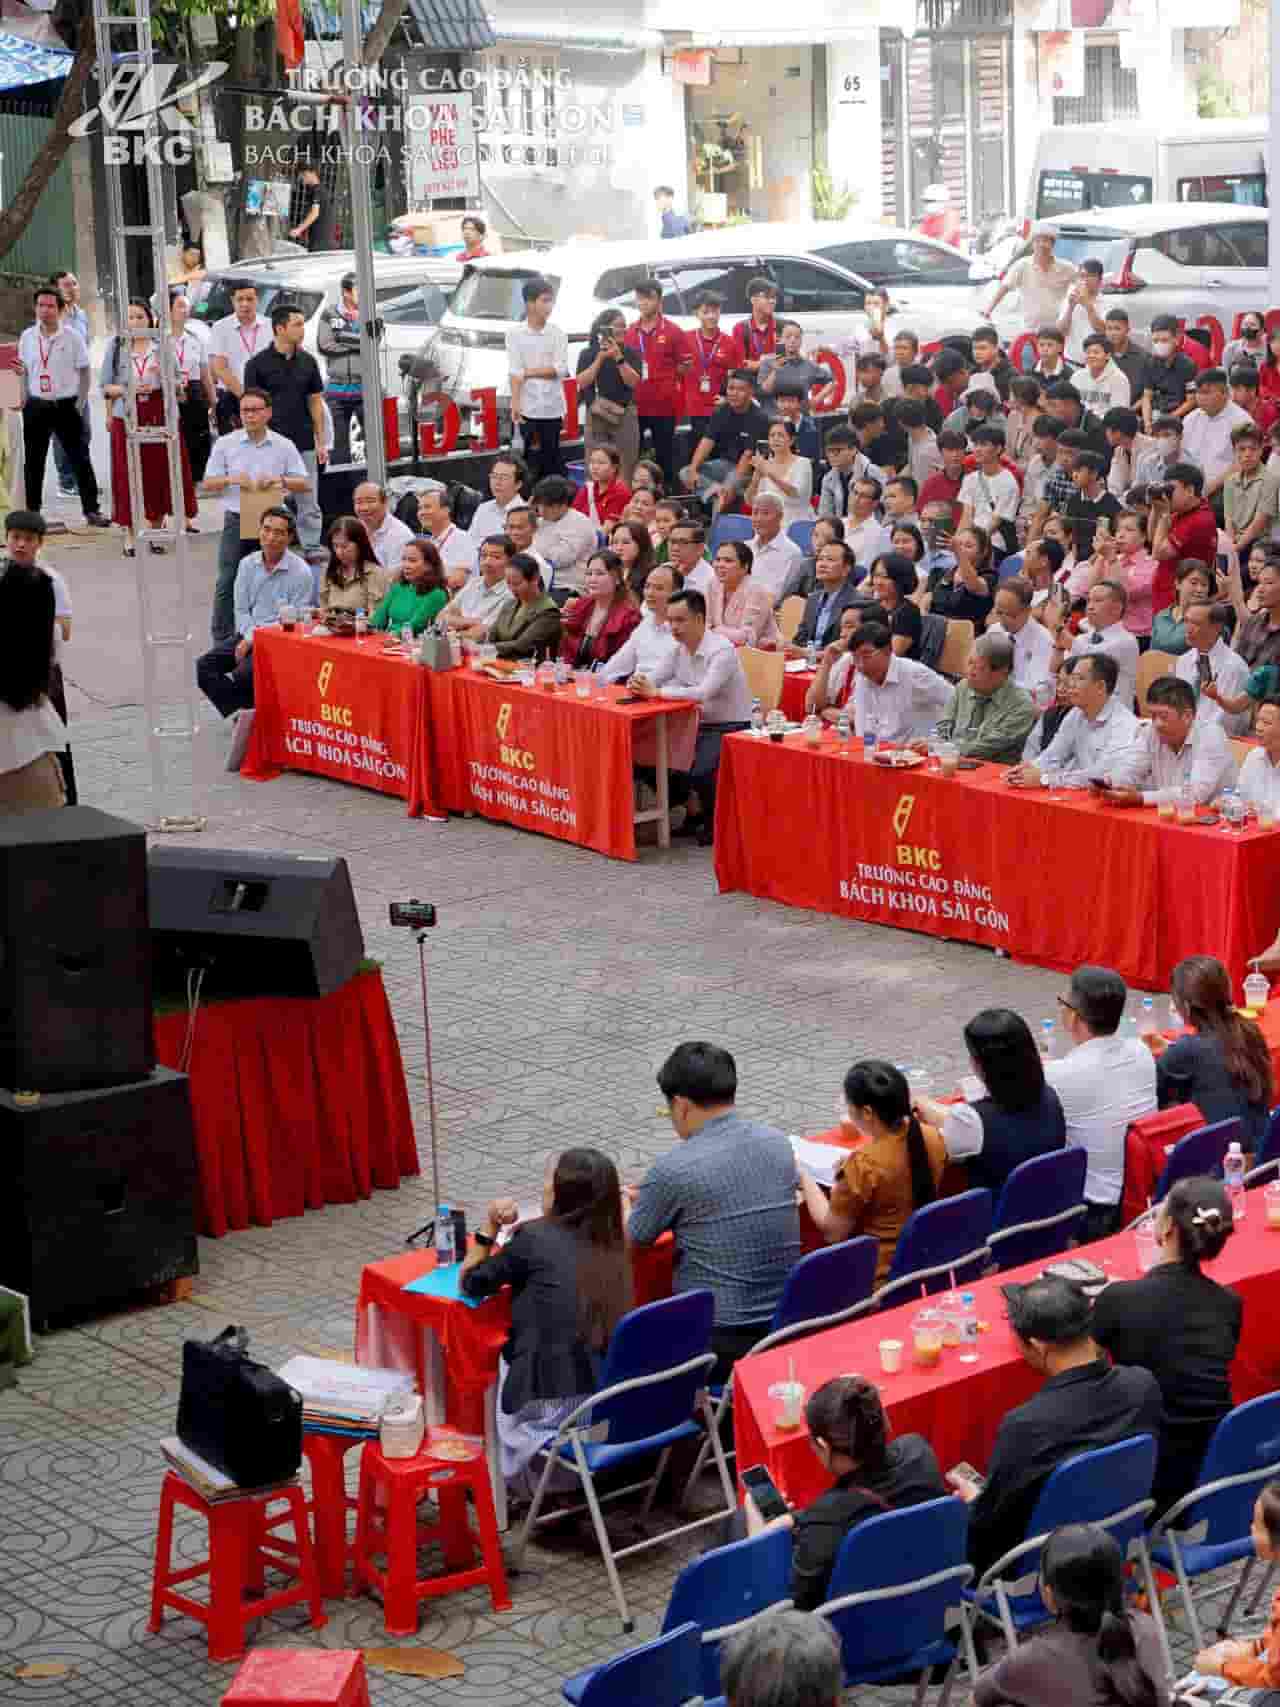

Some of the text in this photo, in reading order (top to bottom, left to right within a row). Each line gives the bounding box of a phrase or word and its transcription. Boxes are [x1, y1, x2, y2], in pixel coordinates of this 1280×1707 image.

[843, 75, 861, 91] 65
[320, 703, 353, 727] BKC
[500, 744, 536, 771] BKC
[895, 844, 943, 871] BKC
[919, 873, 949, 894] CAO
[839, 877, 885, 906] BÁCH
[888, 890, 938, 917] KHOA
